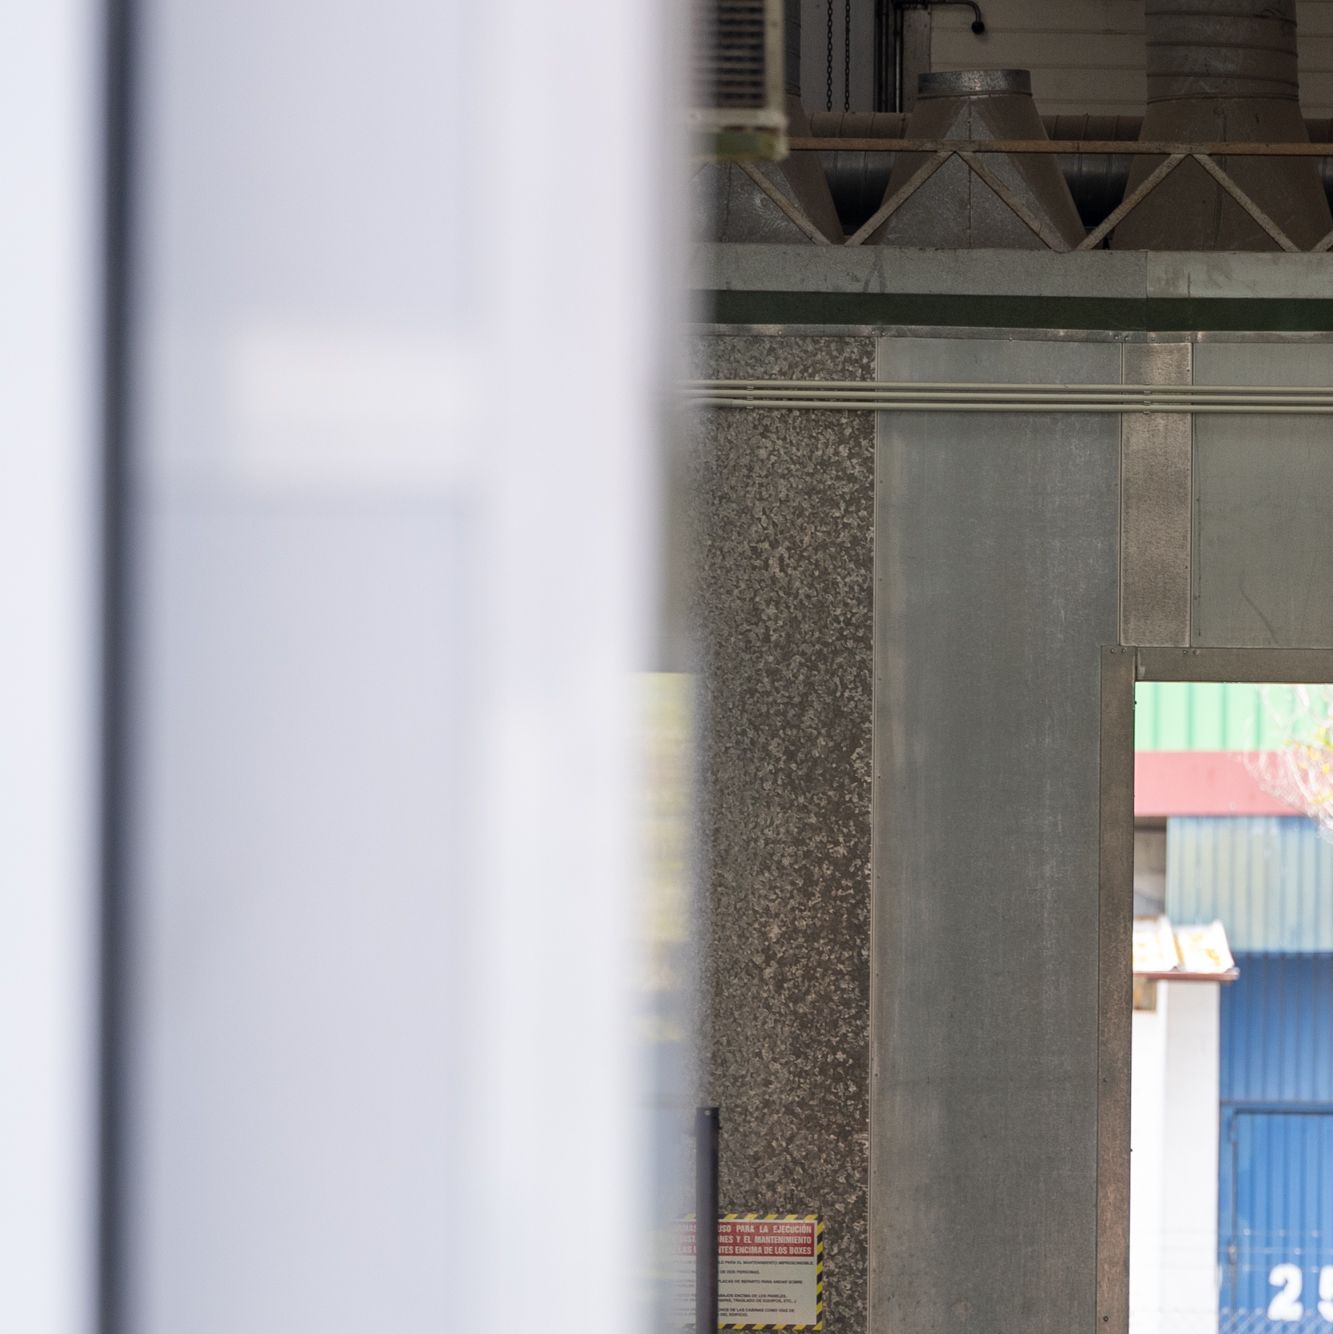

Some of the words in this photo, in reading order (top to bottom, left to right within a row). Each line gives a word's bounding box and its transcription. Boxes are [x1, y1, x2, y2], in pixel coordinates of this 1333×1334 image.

[736, 1224, 755, 1233] PARA
[759, 1224, 769, 1233] LA
[772, 1224, 812, 1234] EJECUCIÓN
[735, 1235, 741, 1243] Y
[743, 1235, 753, 1244] EL
[754, 1235, 812, 1244] MANTENIMIENTO
[735, 1245, 763, 1254] ENCIMA
[763, 1246, 773, 1254] DE
[774, 1246, 788, 1255] LOS
[788, 1246, 812, 1255] BOXES
